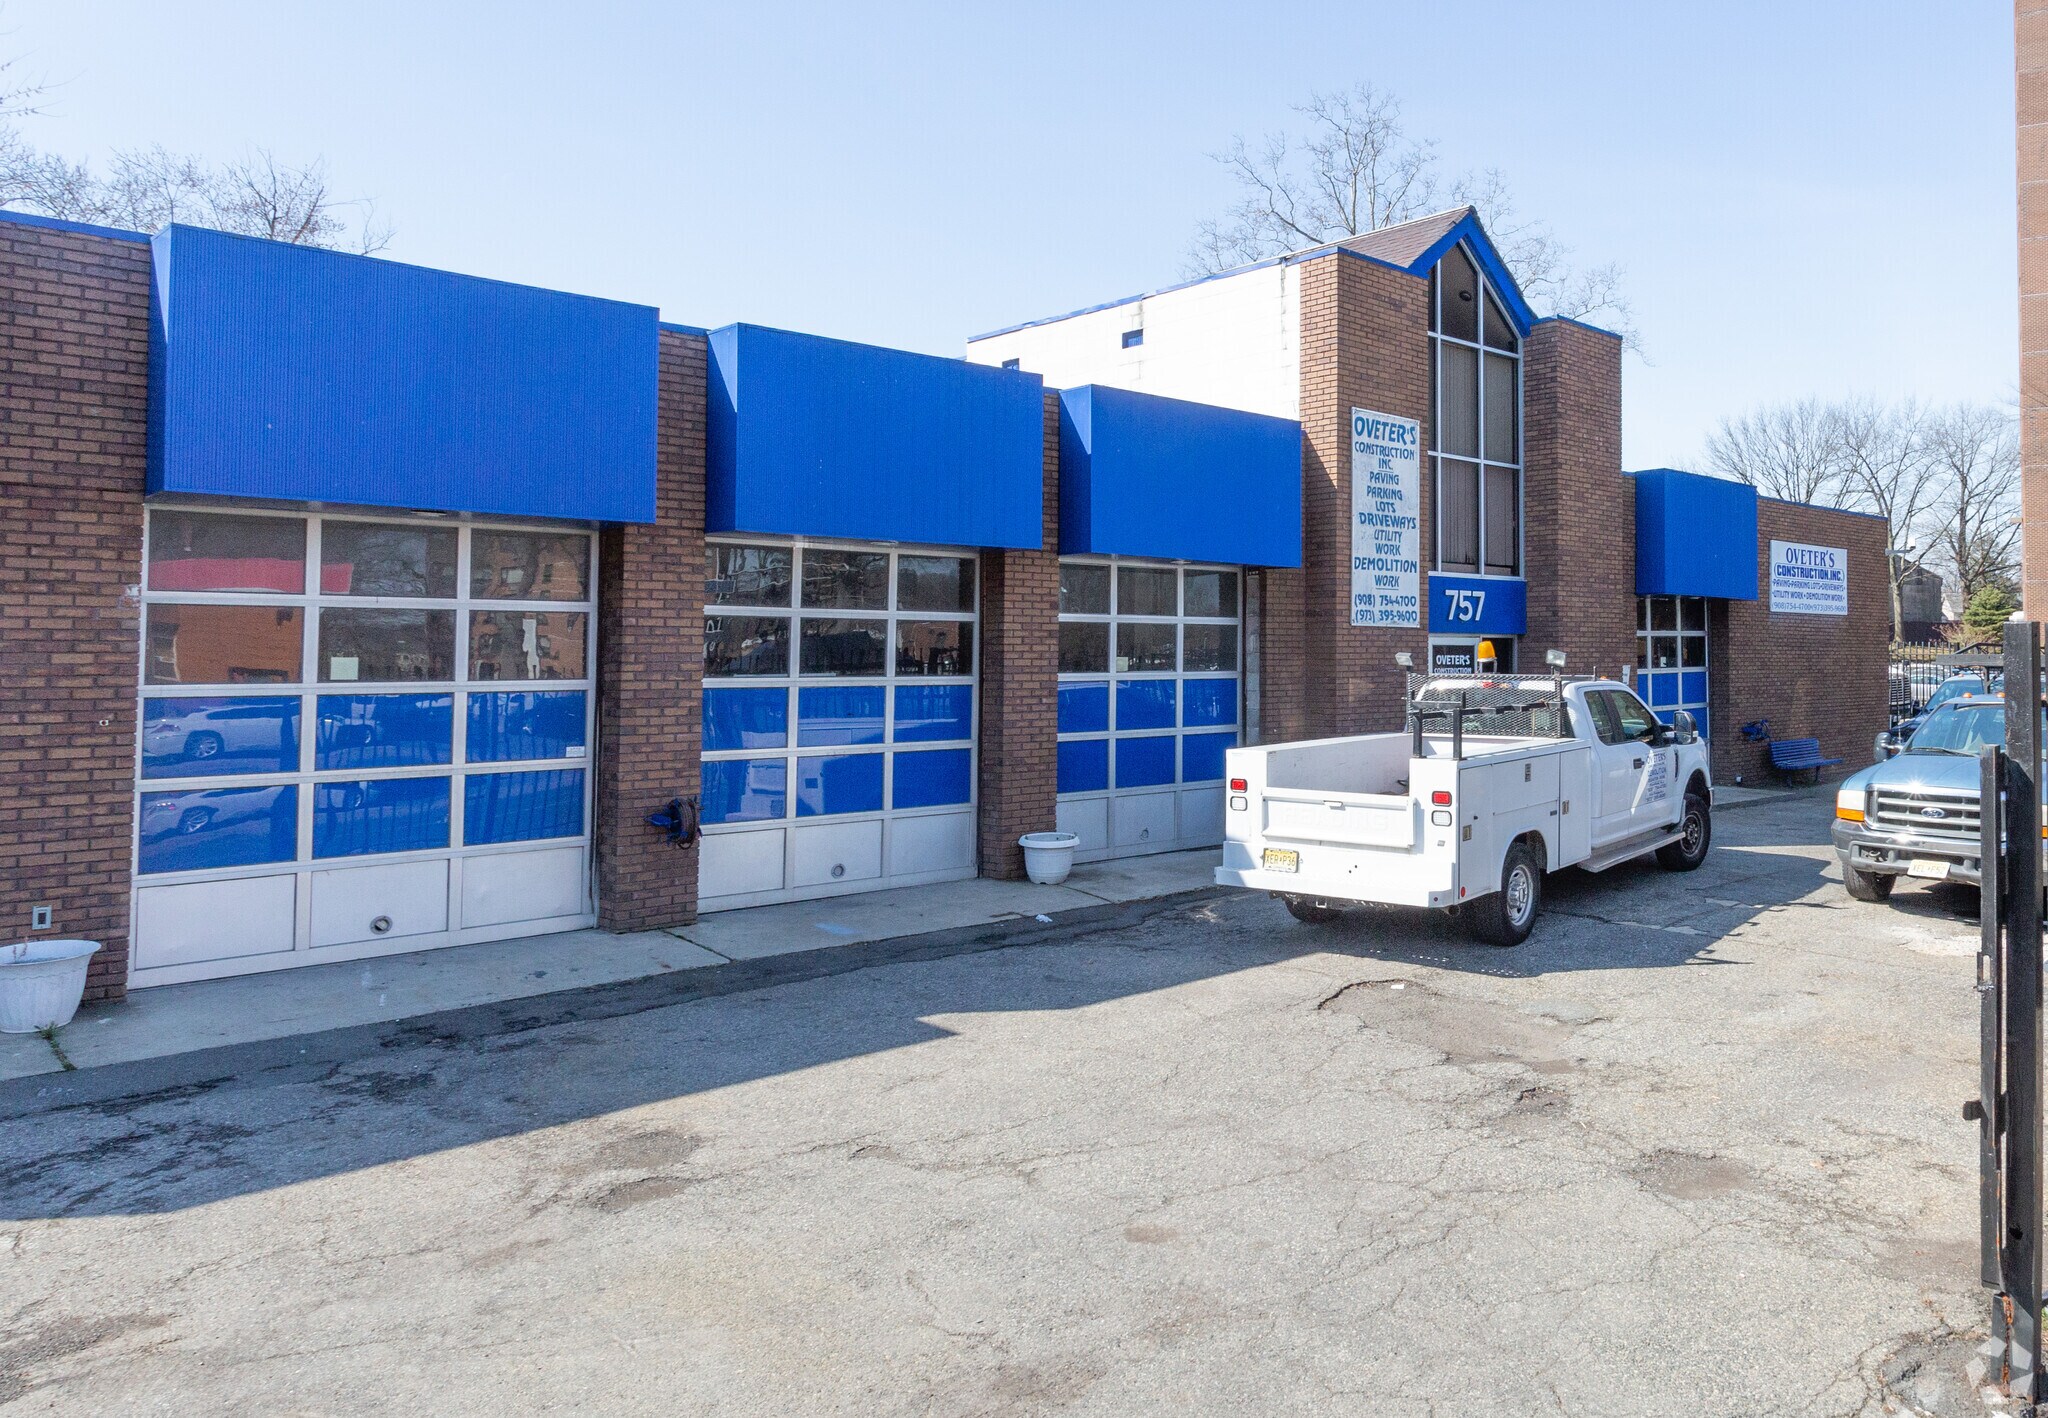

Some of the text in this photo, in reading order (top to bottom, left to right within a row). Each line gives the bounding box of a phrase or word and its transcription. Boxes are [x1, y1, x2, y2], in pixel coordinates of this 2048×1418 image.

[1354, 416, 1416, 446] OVETER'S
[1354, 441, 1415, 460] CONSTRUCTION
[1378, 458, 1394, 470] INC.
[1369, 471, 1400, 486] PAVING
[1366, 485, 1403, 501] PARKING
[1375, 500, 1396, 513] LOTS
[1358, 512, 1417, 530] DRIVEWAYS
[1373, 529, 1403, 543] UTILITY
[1375, 543, 1401, 556] WORK
[1354, 556, 1417, 573] DEMOLITION
[1786, 547, 1835, 568] OVETER'S
[1374, 574, 1400, 588] WORK
[1354, 593, 1417, 608] (908) 754-4700
[1445, 589, 1486, 621] 757
[1355, 609, 1418, 624] (973) 395-9600
